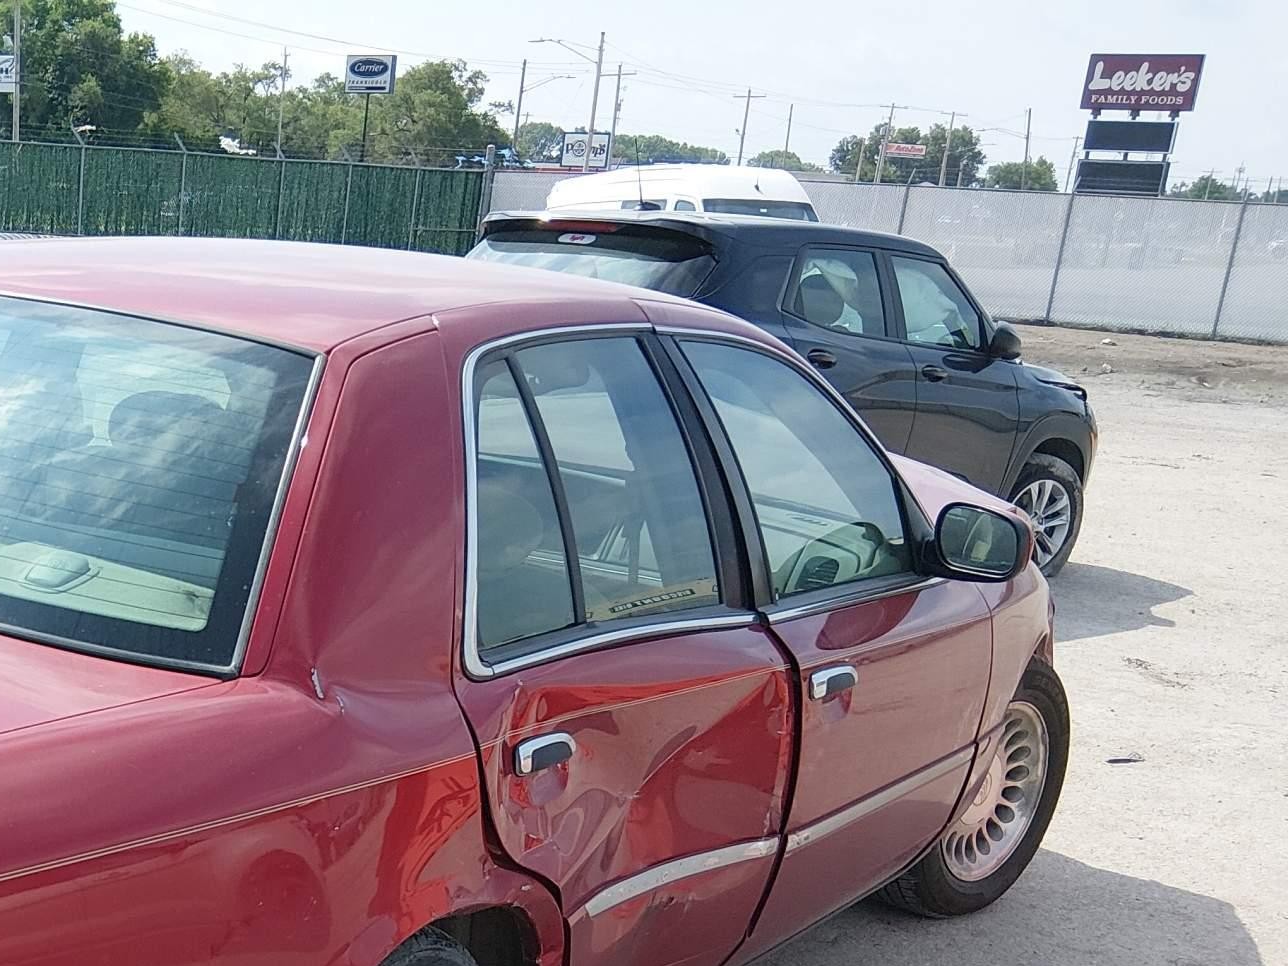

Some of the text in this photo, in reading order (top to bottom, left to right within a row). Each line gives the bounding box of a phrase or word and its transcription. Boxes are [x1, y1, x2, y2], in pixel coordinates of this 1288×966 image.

[354, 62, 384, 72] Carrier
[1088, 60, 1195, 92] Leeker's
[1091, 94, 1183, 105] FAMILY FOODS
